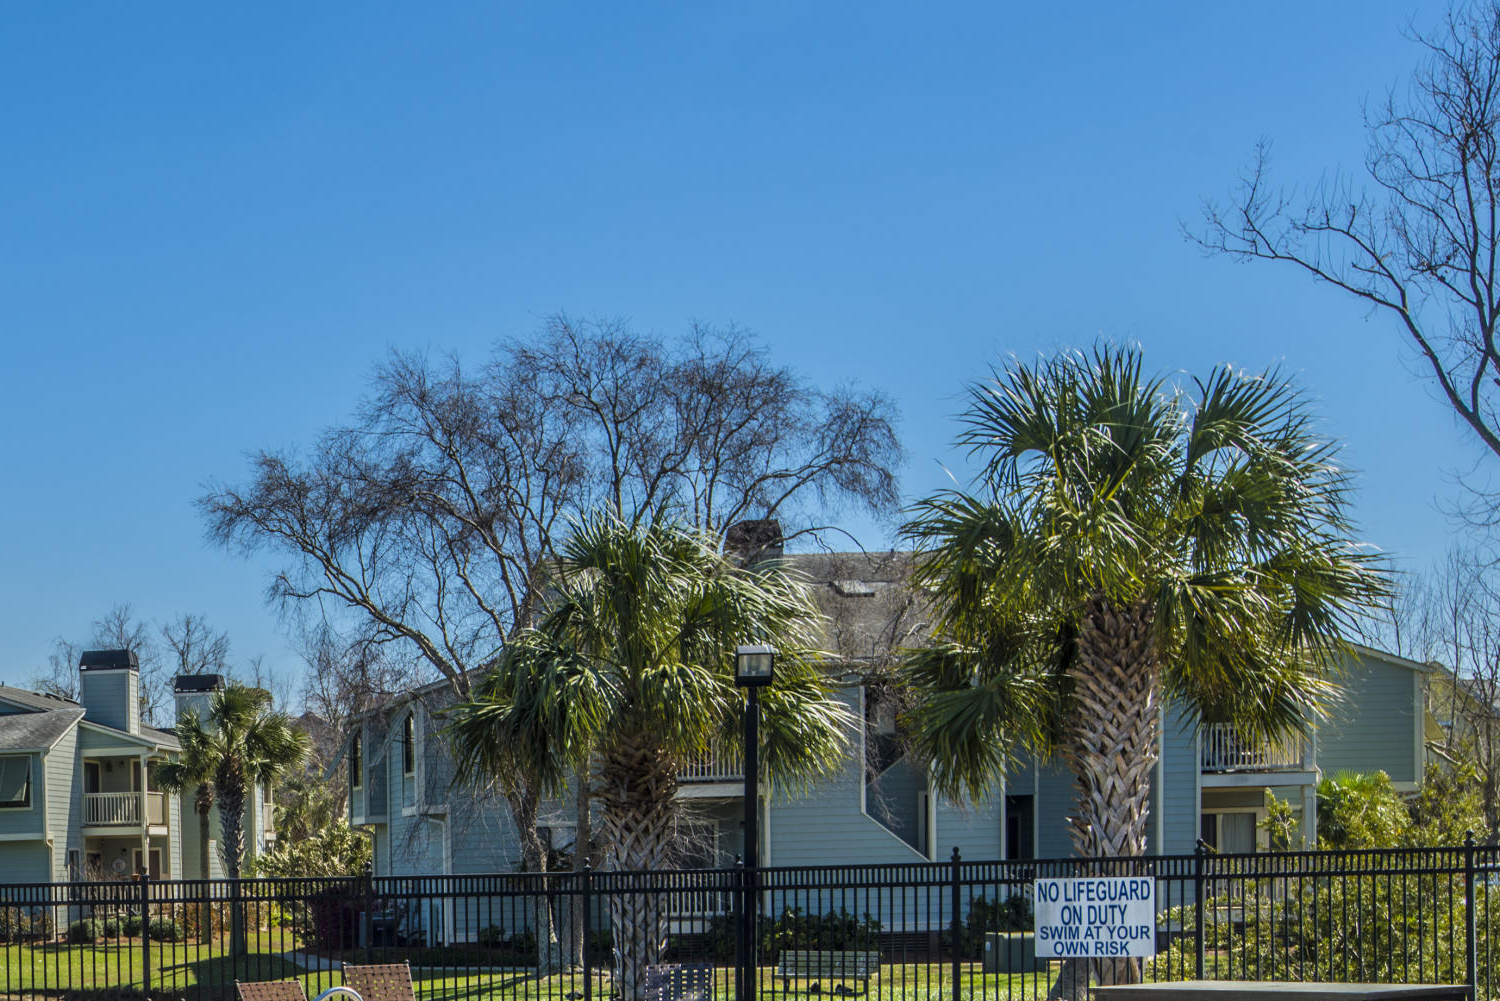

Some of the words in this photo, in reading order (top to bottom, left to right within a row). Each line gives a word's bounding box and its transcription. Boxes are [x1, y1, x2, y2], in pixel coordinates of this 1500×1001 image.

[1038, 881, 1059, 902] NO
[1064, 880, 1150, 902] LIFEGUARD
[1061, 905, 1082, 925] ON
[1088, 904, 1127, 925] DUTY
[1040, 926, 1079, 940] SWIM
[1084, 926, 1103, 940] AT
[1106, 925, 1150, 940] YOUR
[1053, 941, 1089, 956] OWN
[1094, 941, 1130, 956] RISK
